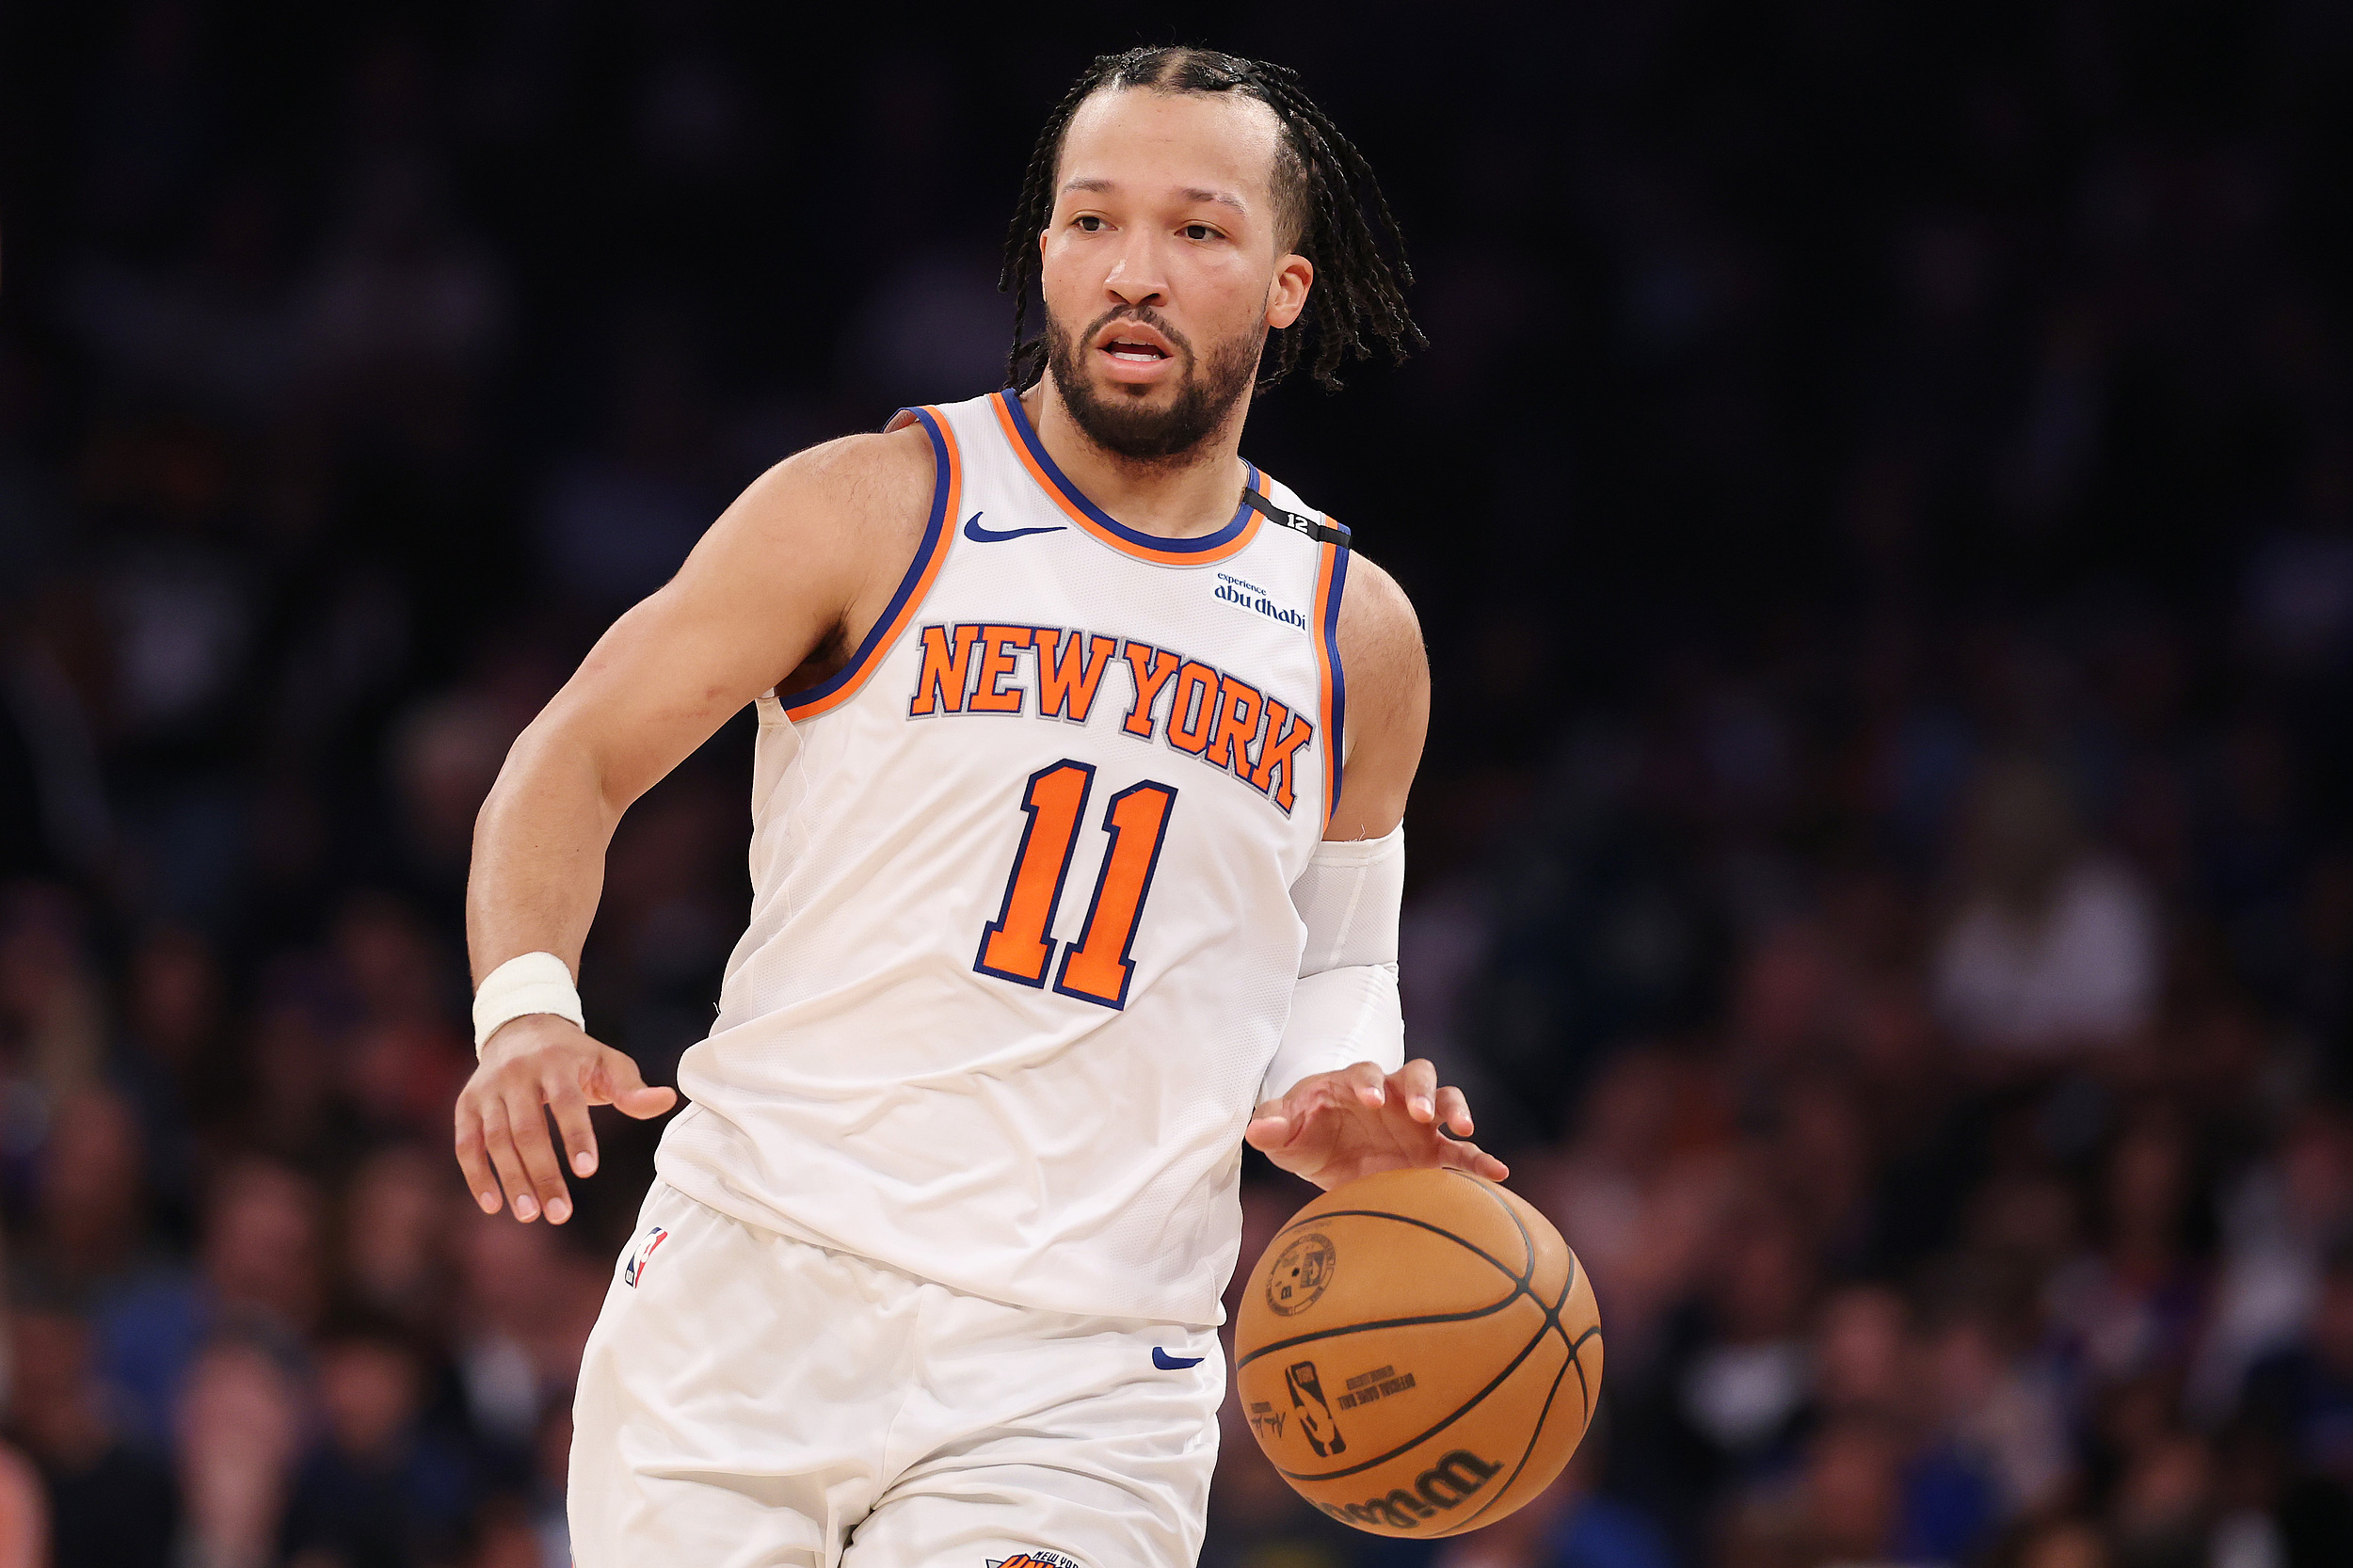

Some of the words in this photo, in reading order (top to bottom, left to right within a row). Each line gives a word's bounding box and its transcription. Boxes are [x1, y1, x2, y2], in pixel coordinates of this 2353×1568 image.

[1287, 513, 1309, 534] 12
[1217, 571, 1267, 596] experience
[1214, 584, 1251, 609] abu
[1255, 598, 1306, 631] dhabi
[908, 621, 1119, 725] NEW
[1120, 635, 1316, 819] YORK
[972, 758, 1178, 1012] 11
[1306, 1449, 1505, 1529] Wilso
[1032, 1550, 1060, 1563] NEW
[1060, 1556, 1080, 1568] YO
